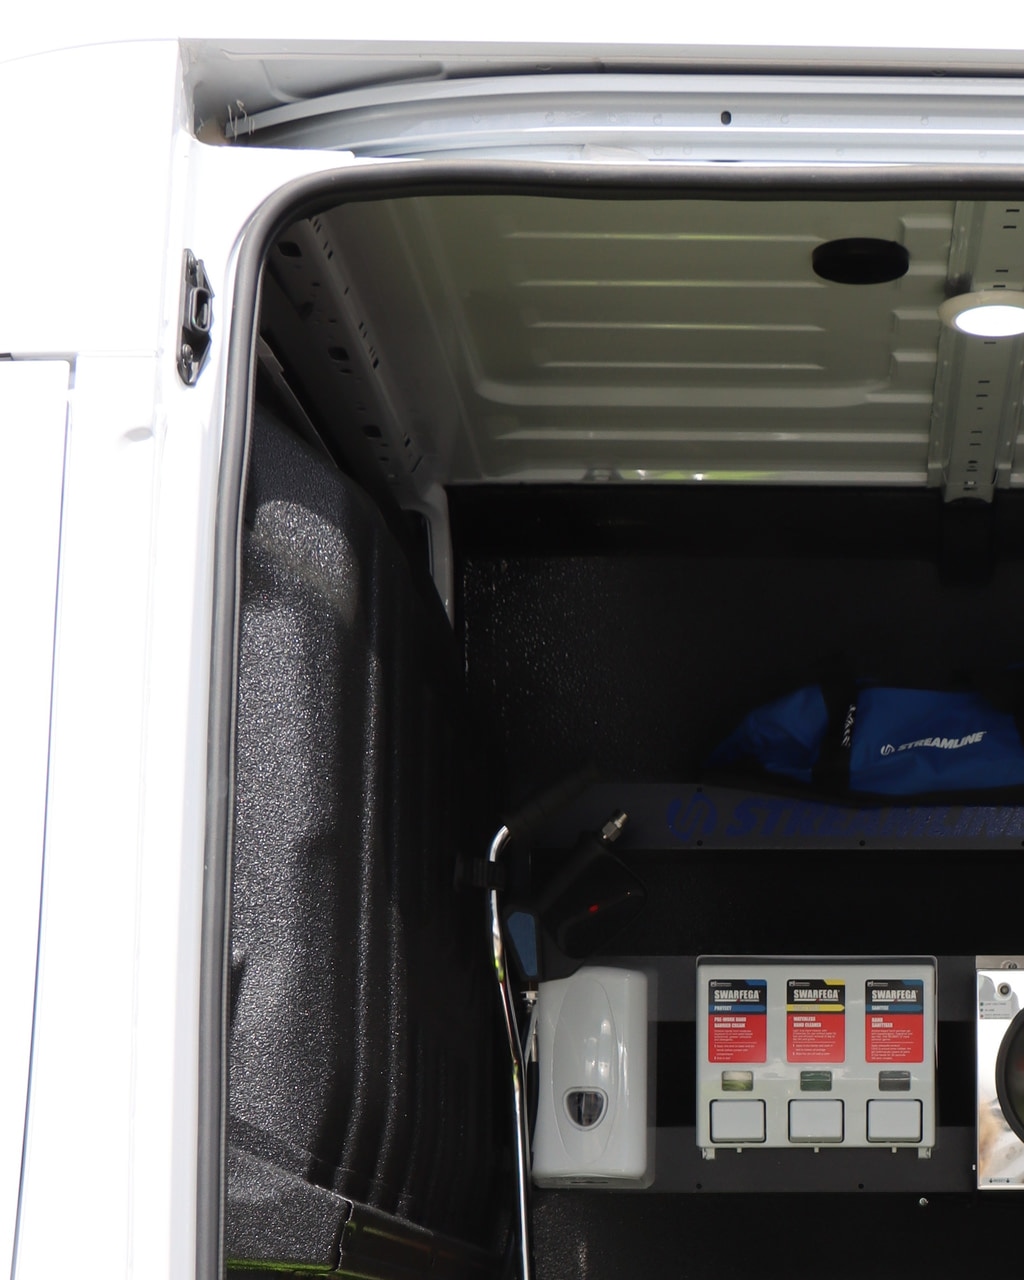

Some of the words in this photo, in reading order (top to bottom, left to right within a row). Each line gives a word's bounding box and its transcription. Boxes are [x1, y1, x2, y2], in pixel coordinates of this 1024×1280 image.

[897, 731, 986, 751] STREAMLINE
[714, 989, 759, 1000] SWARFEGA
[793, 989, 839, 999] SWARFEGA
[871, 989, 917, 1000] SWARFEGA
